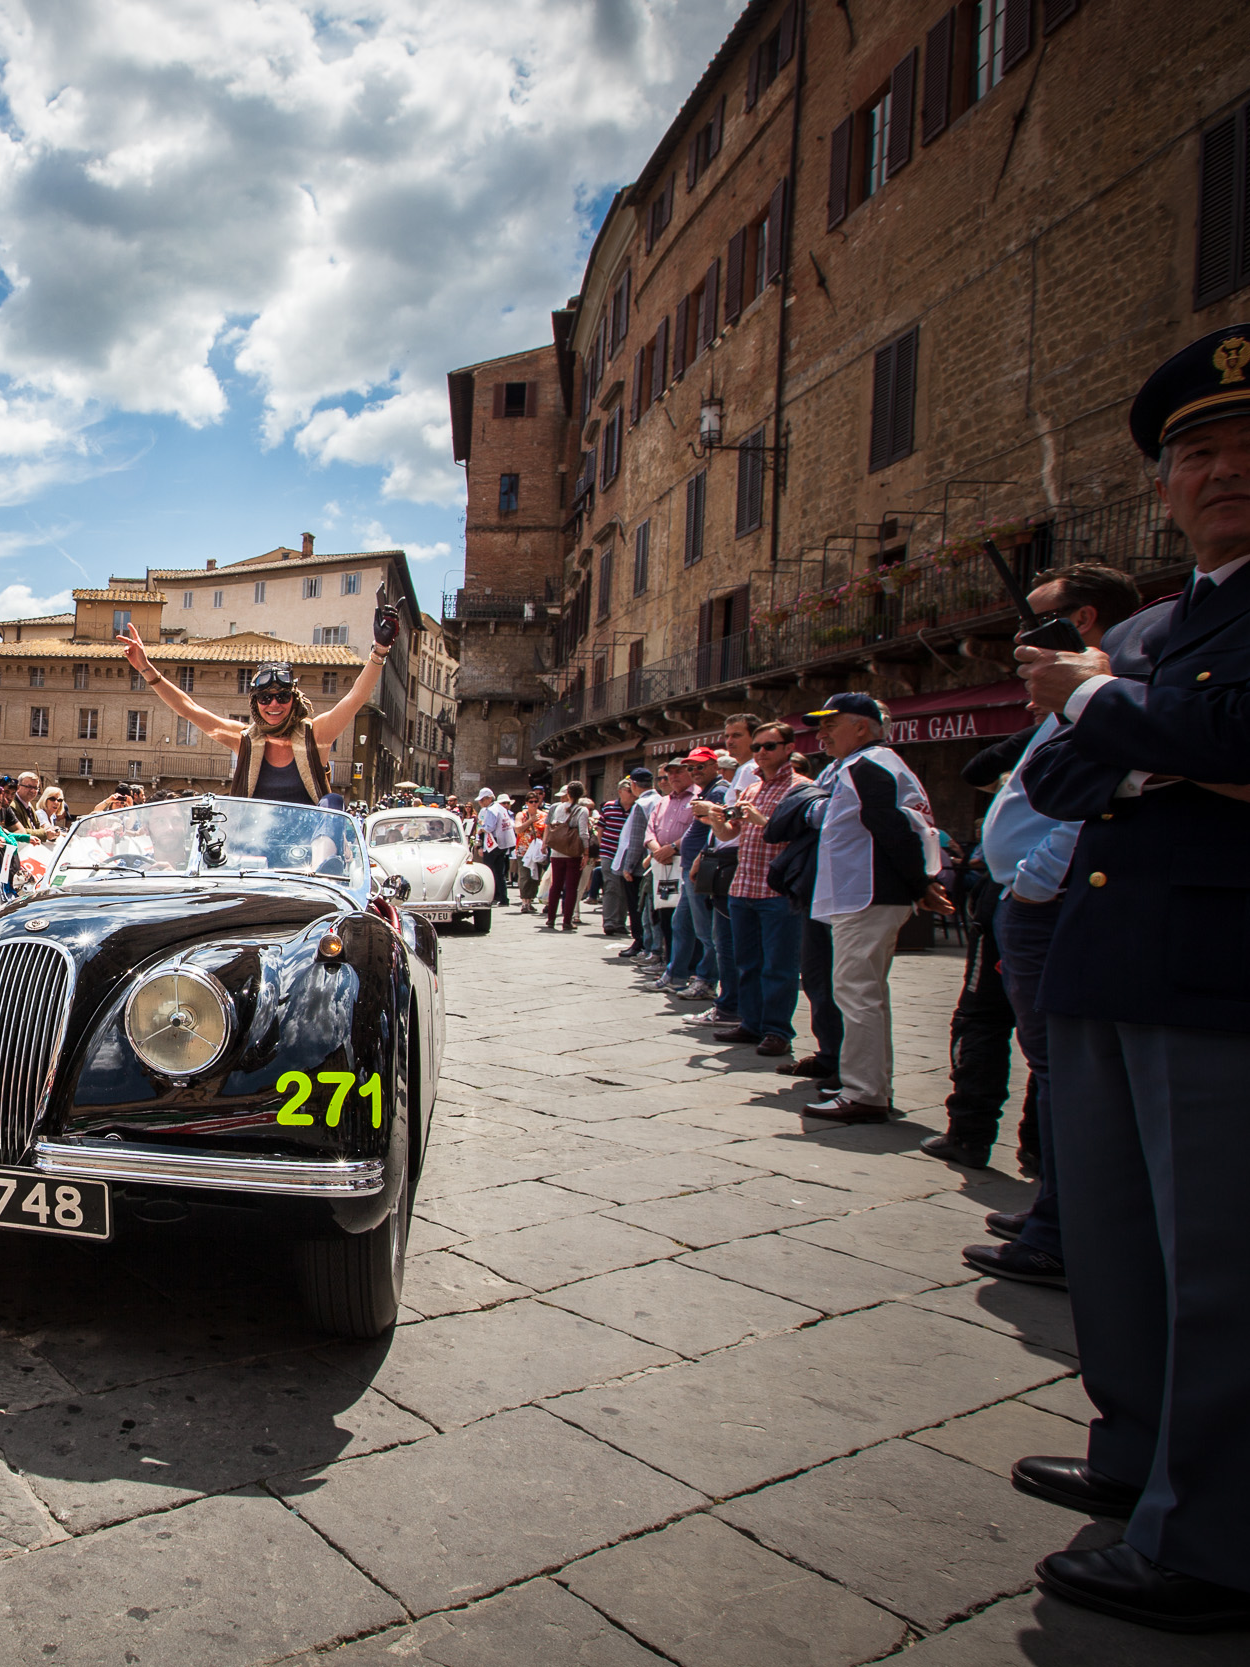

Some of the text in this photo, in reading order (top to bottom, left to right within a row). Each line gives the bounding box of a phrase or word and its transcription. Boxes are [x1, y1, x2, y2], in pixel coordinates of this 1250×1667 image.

[929, 713, 978, 740] GAIA
[653, 743, 675, 756] FOTO
[275, 1070, 384, 1130] 271
